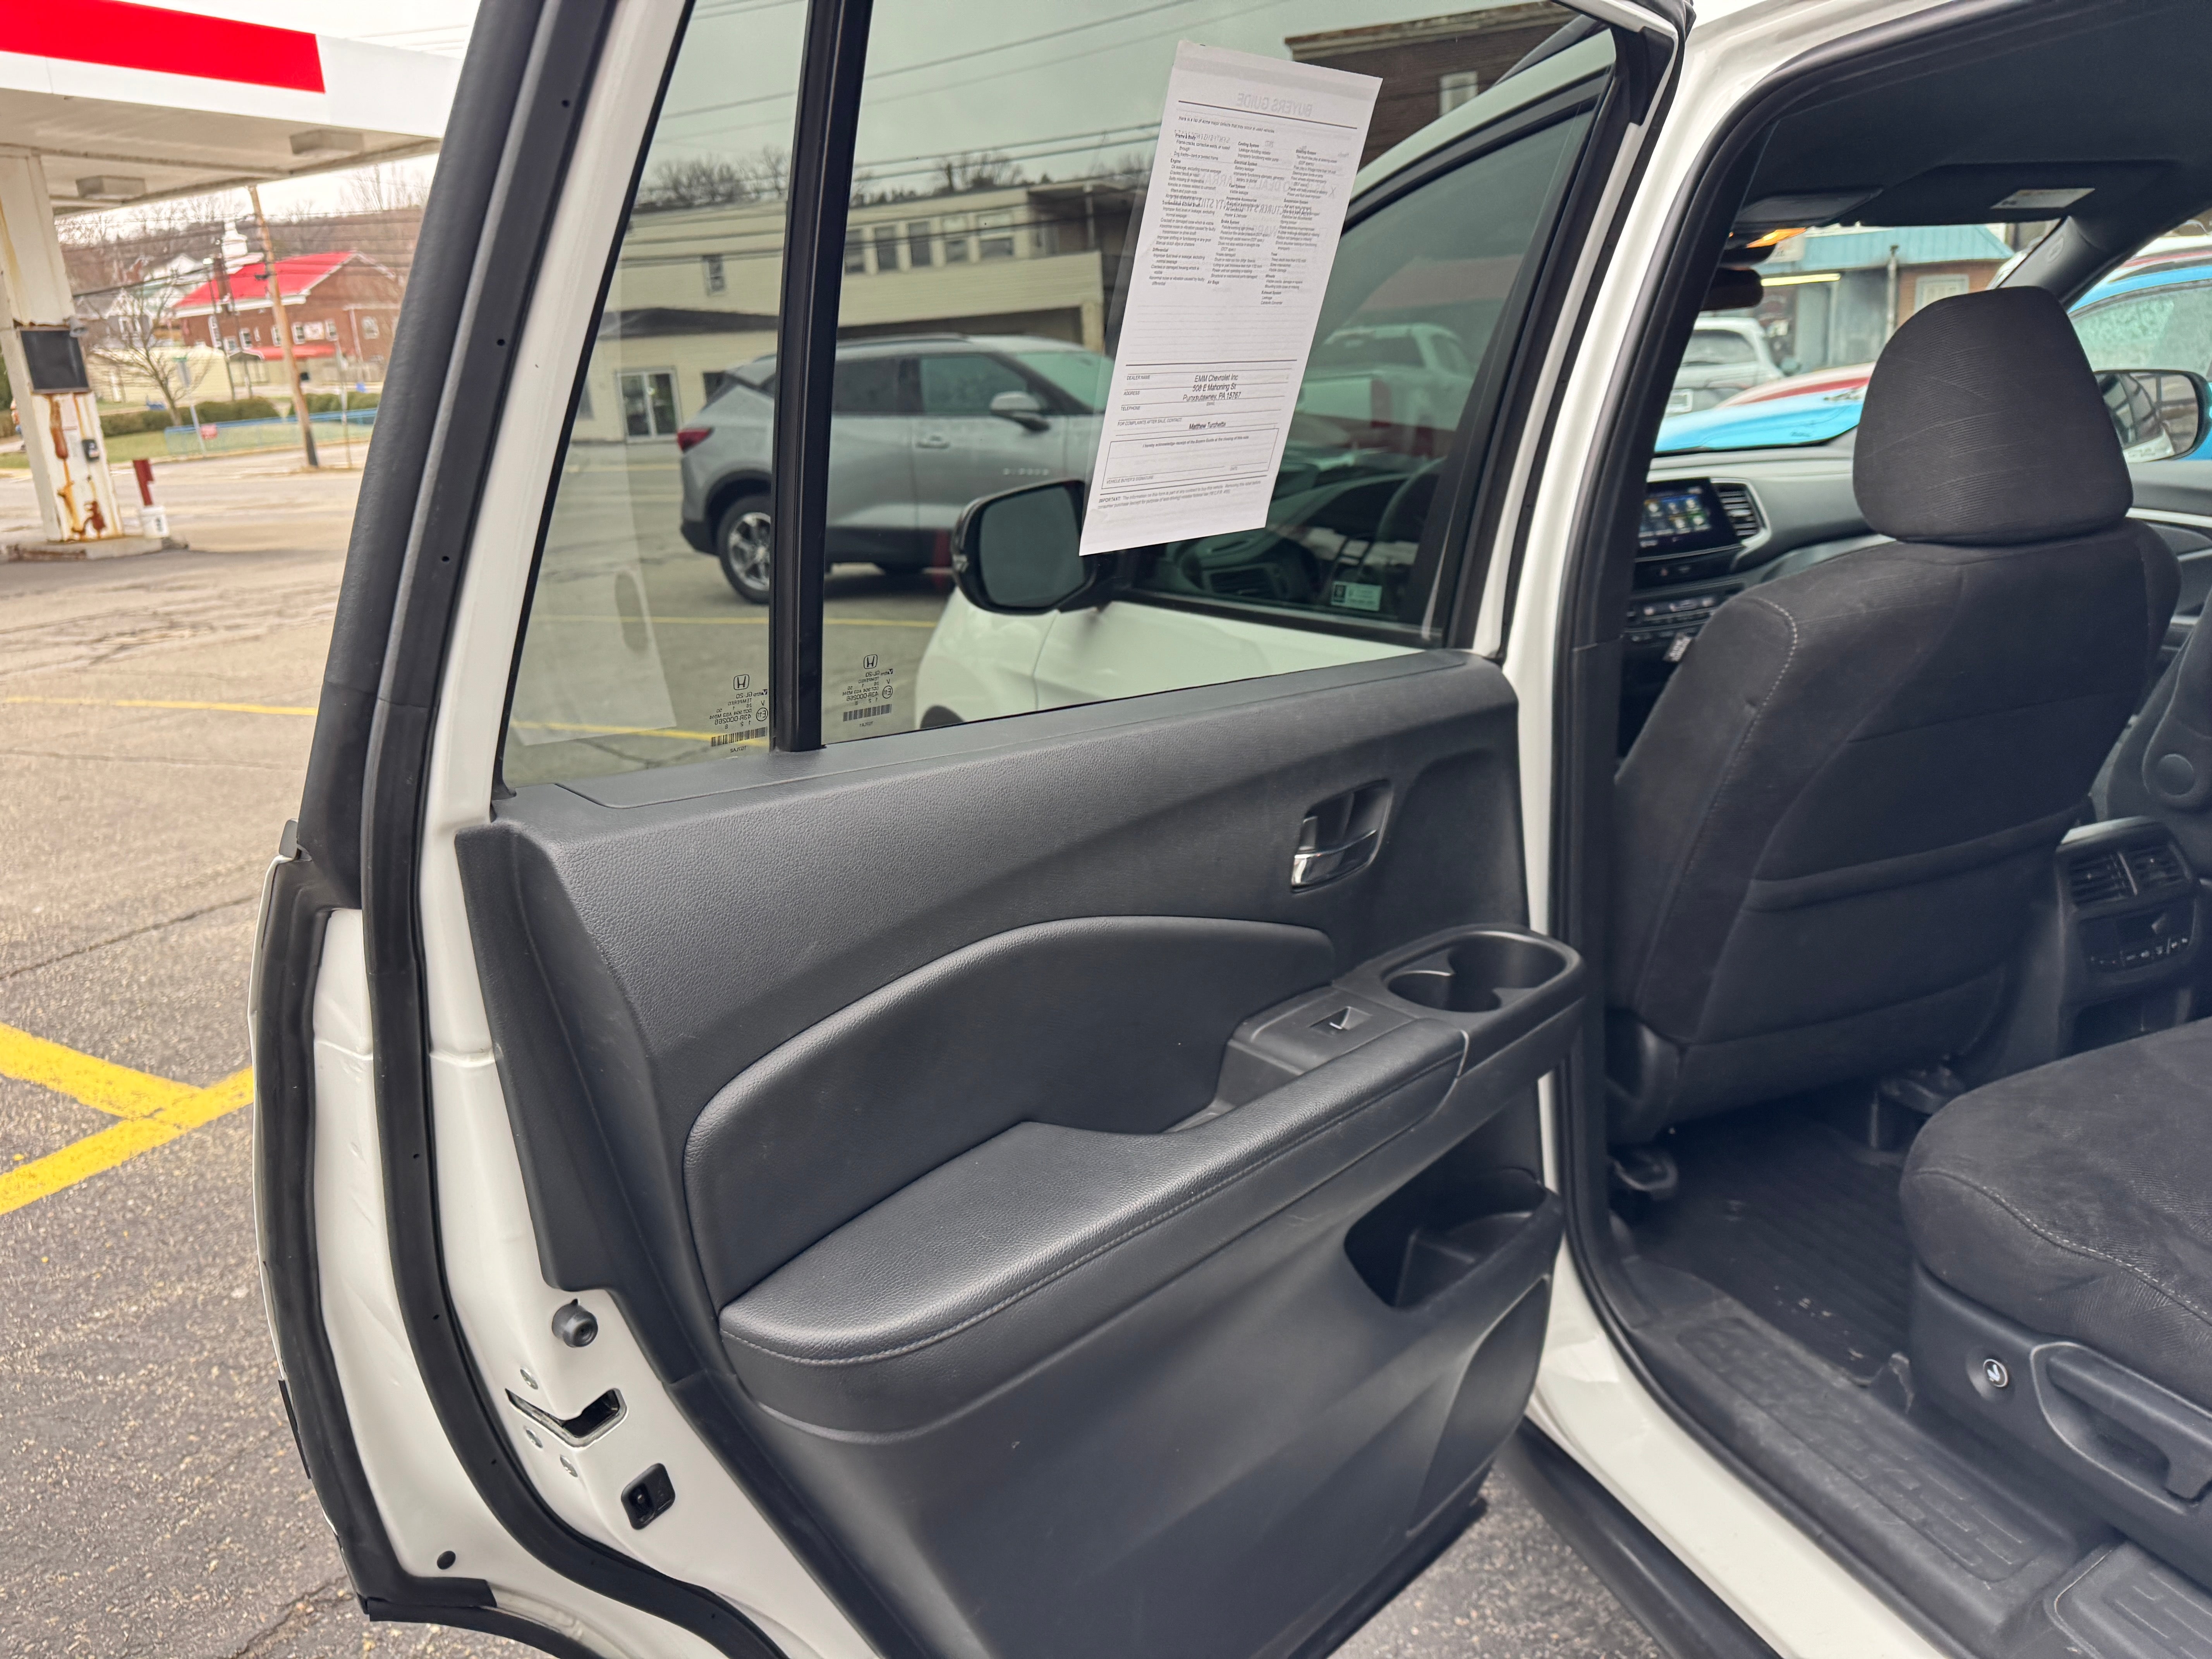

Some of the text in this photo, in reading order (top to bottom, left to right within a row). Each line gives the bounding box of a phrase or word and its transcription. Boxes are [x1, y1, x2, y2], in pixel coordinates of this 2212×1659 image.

[1208, 374, 1230, 382] Chevrolet
[1207, 383, 1230, 392] Mahoning
[1226, 392, 1241, 400] 15767
